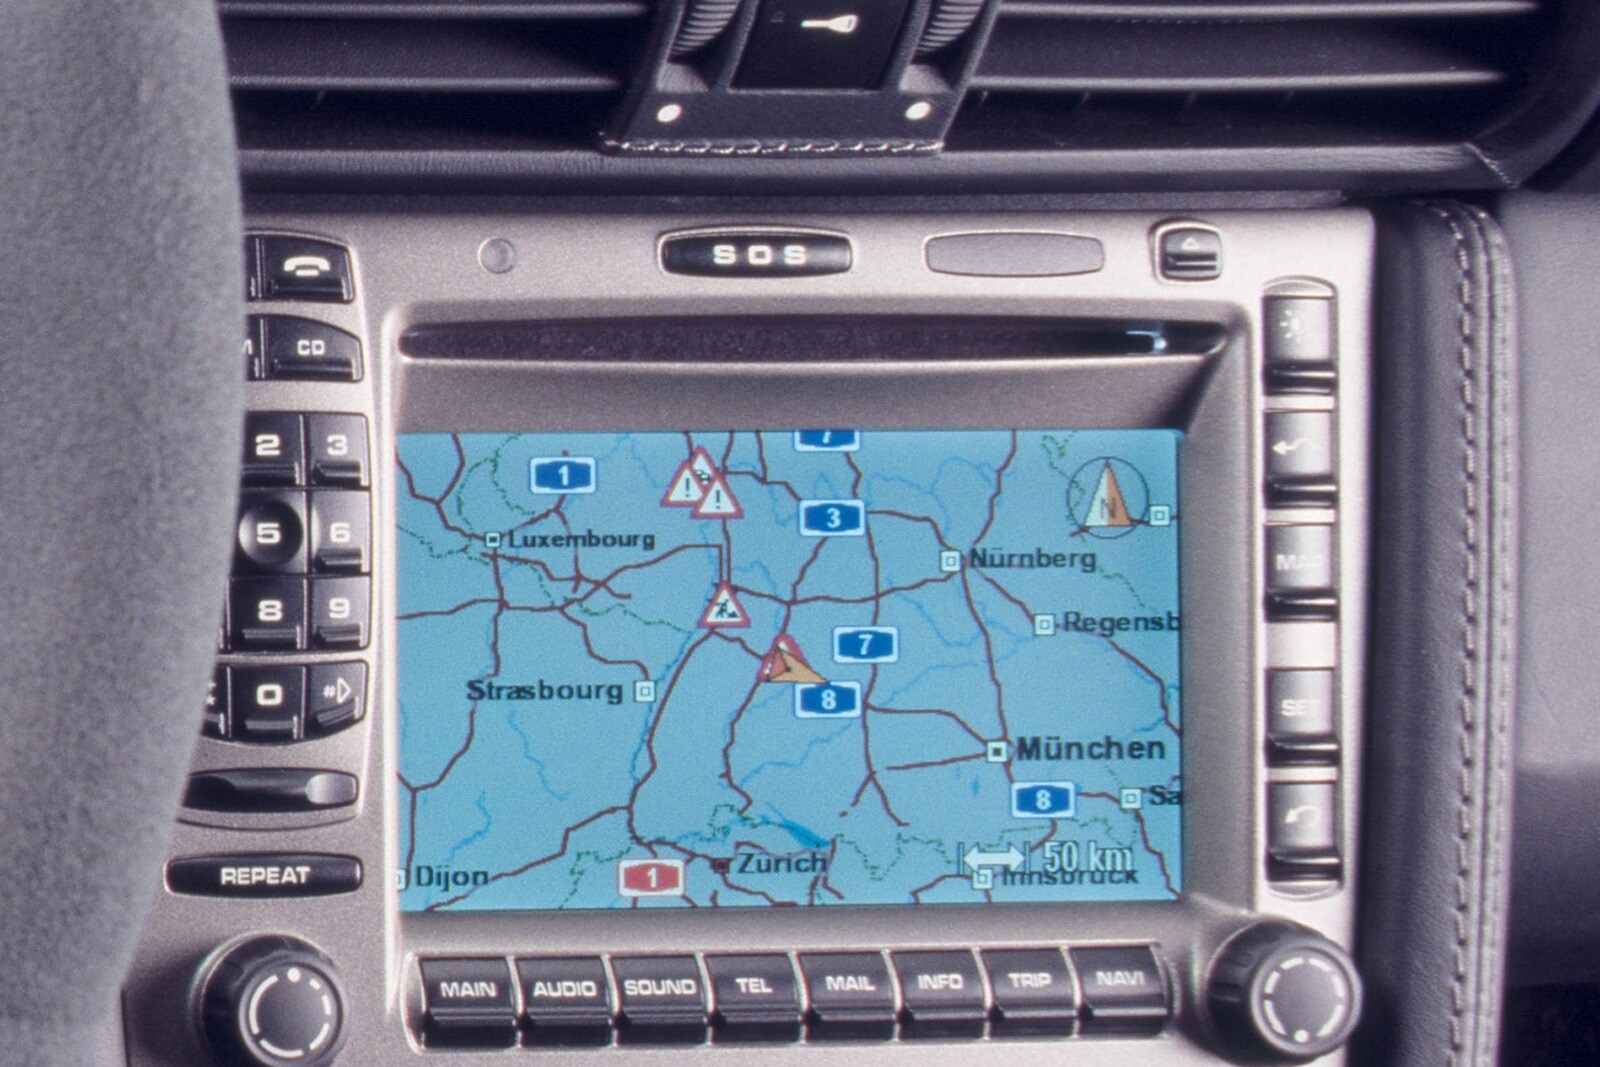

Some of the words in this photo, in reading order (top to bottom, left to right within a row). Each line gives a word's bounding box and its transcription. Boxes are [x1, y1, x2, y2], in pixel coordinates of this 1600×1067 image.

[712, 244, 807, 266] SOS
[297, 339, 325, 356] CD
[255, 434, 281, 456] 2
[326, 434, 349, 456] 3
[557, 464, 570, 487] 1
[826, 507, 842, 529] 3
[255, 522, 282, 544] 5
[330, 522, 351, 543] 6
[508, 528, 656, 551] Luxembourg
[970, 547, 1097, 573] Nürnberg
[257, 599, 283, 621] 8
[328, 597, 350, 619] 9
[1064, 610, 1181, 638] Regensb
[858, 633, 874, 655] 7
[466, 679, 623, 705] Strasbourg
[821, 689, 837, 710] 8
[1016, 736, 1166, 761] München
[1035, 788, 1052, 811] 8
[1149, 785, 1181, 806] Sa
[737, 851, 828, 874] Zürich
[1043, 840, 1079, 873] 50
[1088, 840, 1133, 873] km
[220, 866, 311, 885] REPEAT
[416, 865, 489, 891] Dijon
[646, 867, 658, 888] 1
[440, 981, 497, 998] MAIN
[532, 980, 597, 997] AUDIO
[624, 978, 697, 995] SOUND
[735, 977, 773, 994] TEL
[826, 975, 876, 991] MAIL
[917, 974, 963, 990] INFO
[1008, 972, 1053, 988] TRIP
[1095, 971, 1146, 987] NAVI
